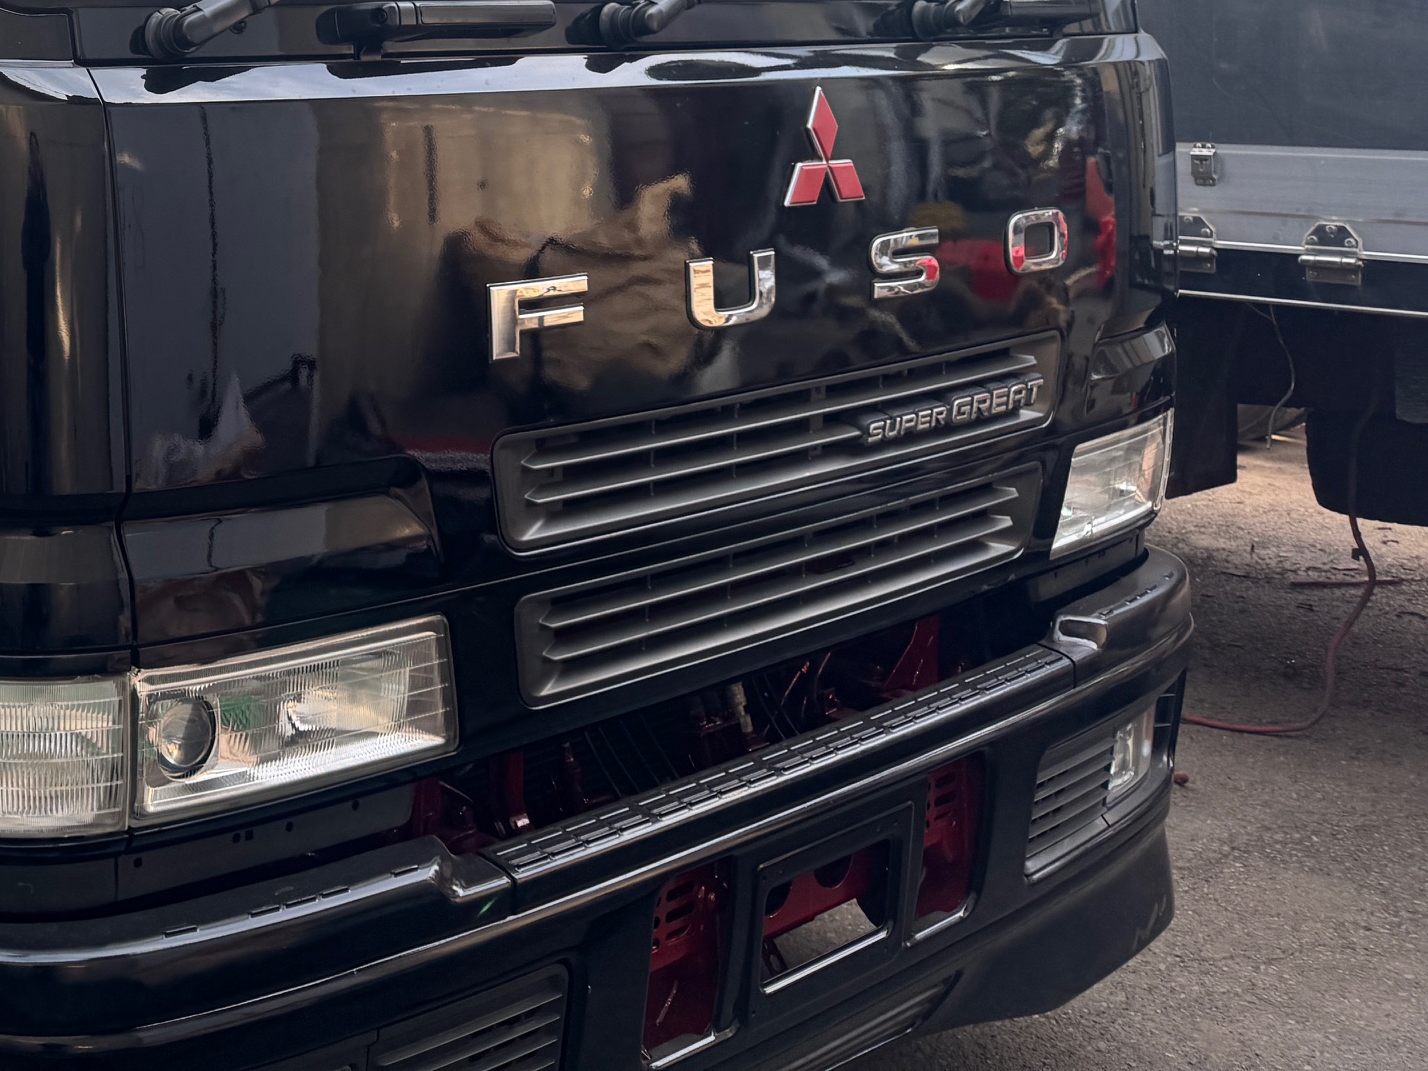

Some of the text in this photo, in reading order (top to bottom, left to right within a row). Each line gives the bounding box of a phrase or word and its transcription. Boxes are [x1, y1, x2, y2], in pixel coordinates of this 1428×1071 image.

[486, 207, 1068, 362] FUSO
[867, 378, 1044, 444] SUPER GREAT
